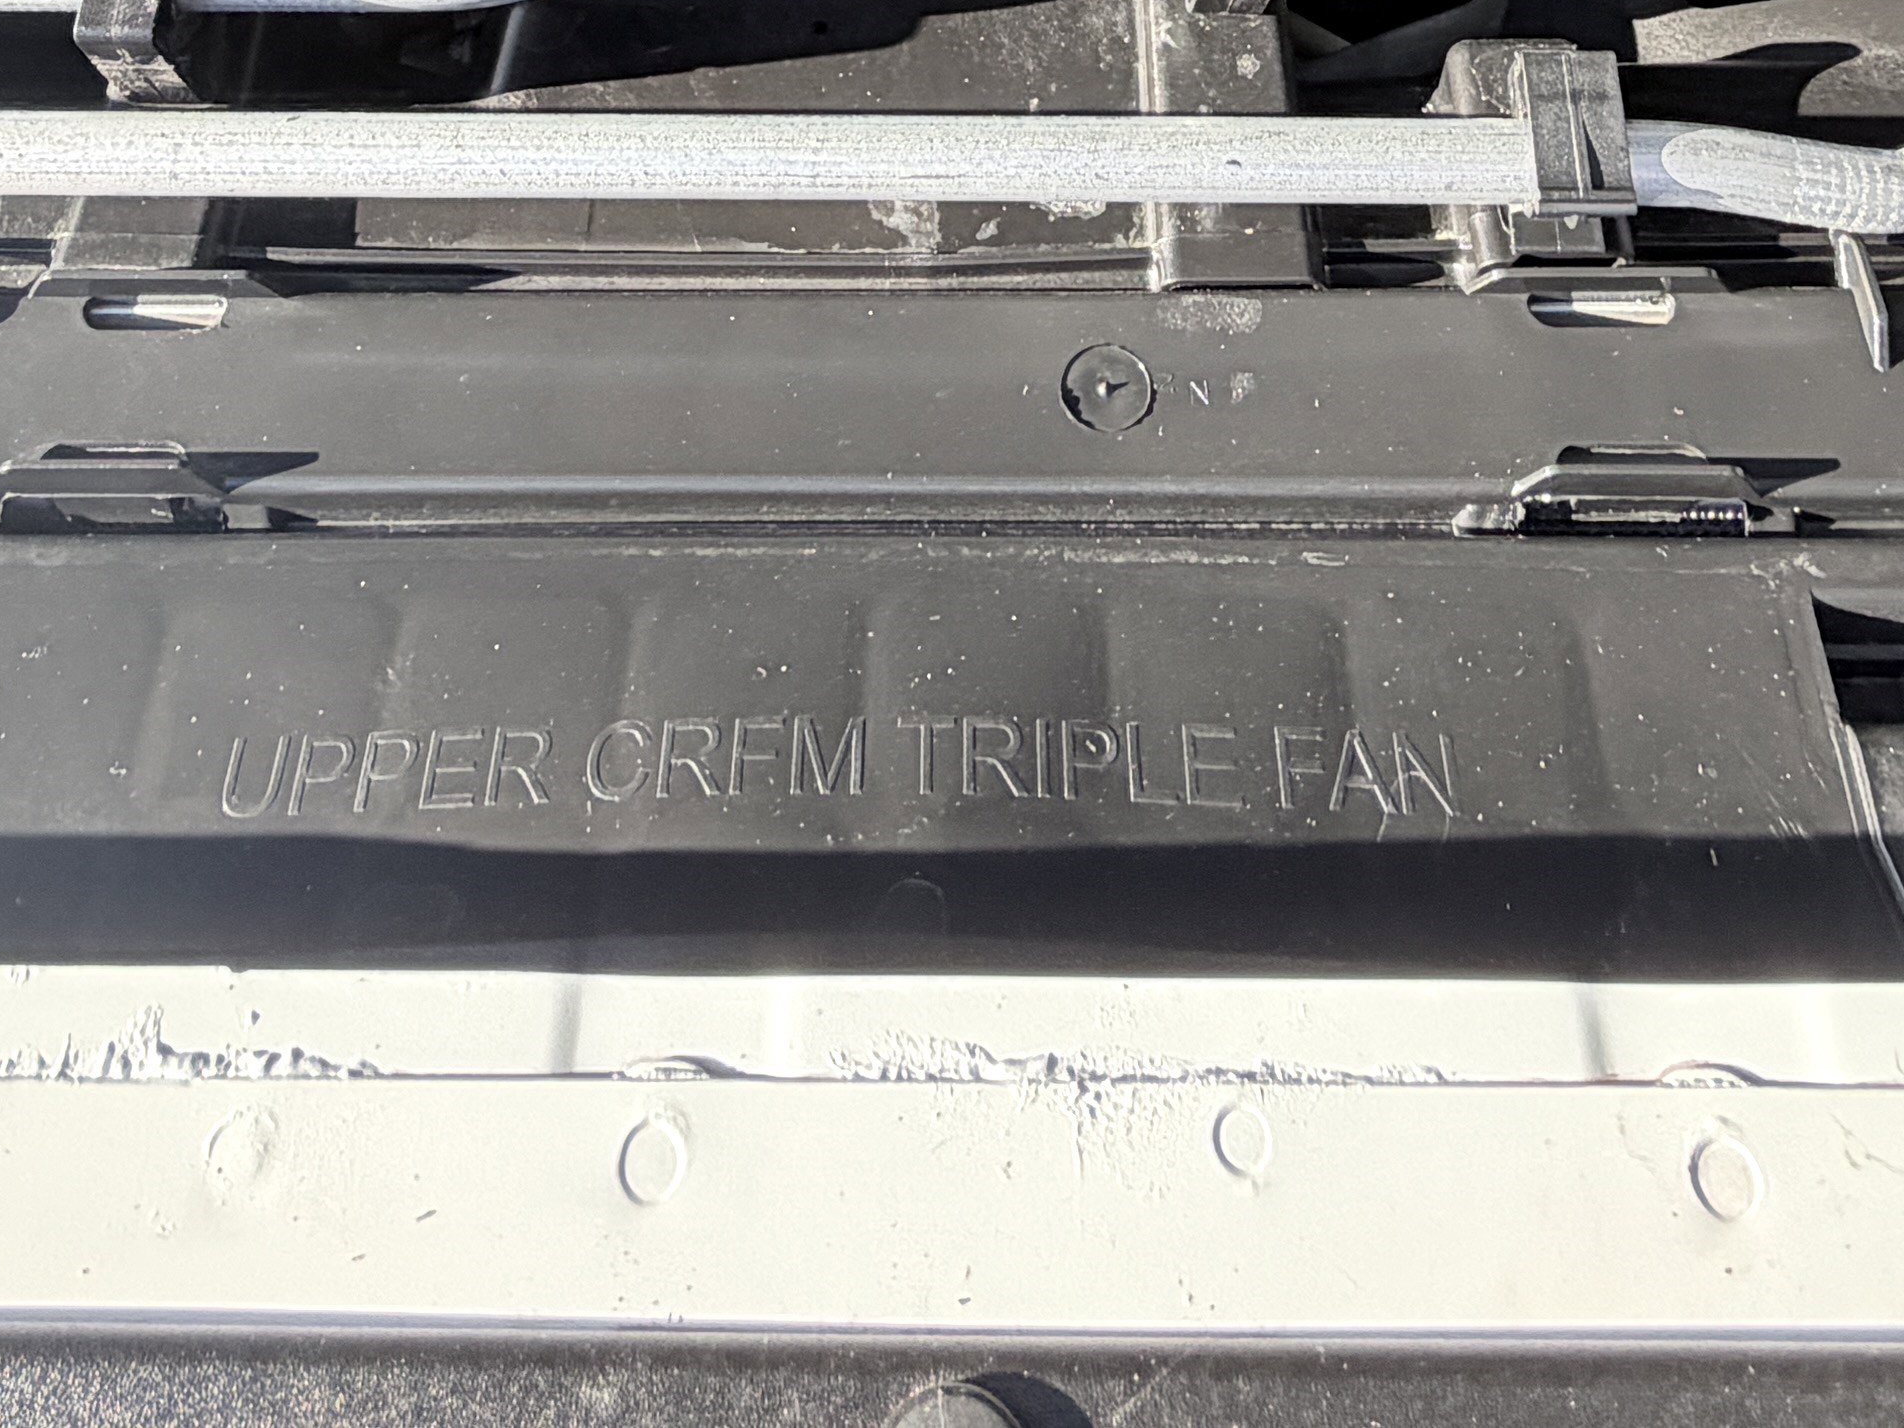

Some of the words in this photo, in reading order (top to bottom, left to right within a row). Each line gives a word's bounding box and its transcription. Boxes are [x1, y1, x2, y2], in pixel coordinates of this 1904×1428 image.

[218, 727, 553, 820] UPPER
[584, 716, 869, 803] CRFM
[900, 716, 1247, 811] TRIPLE
[1270, 725, 1457, 818] FAN
